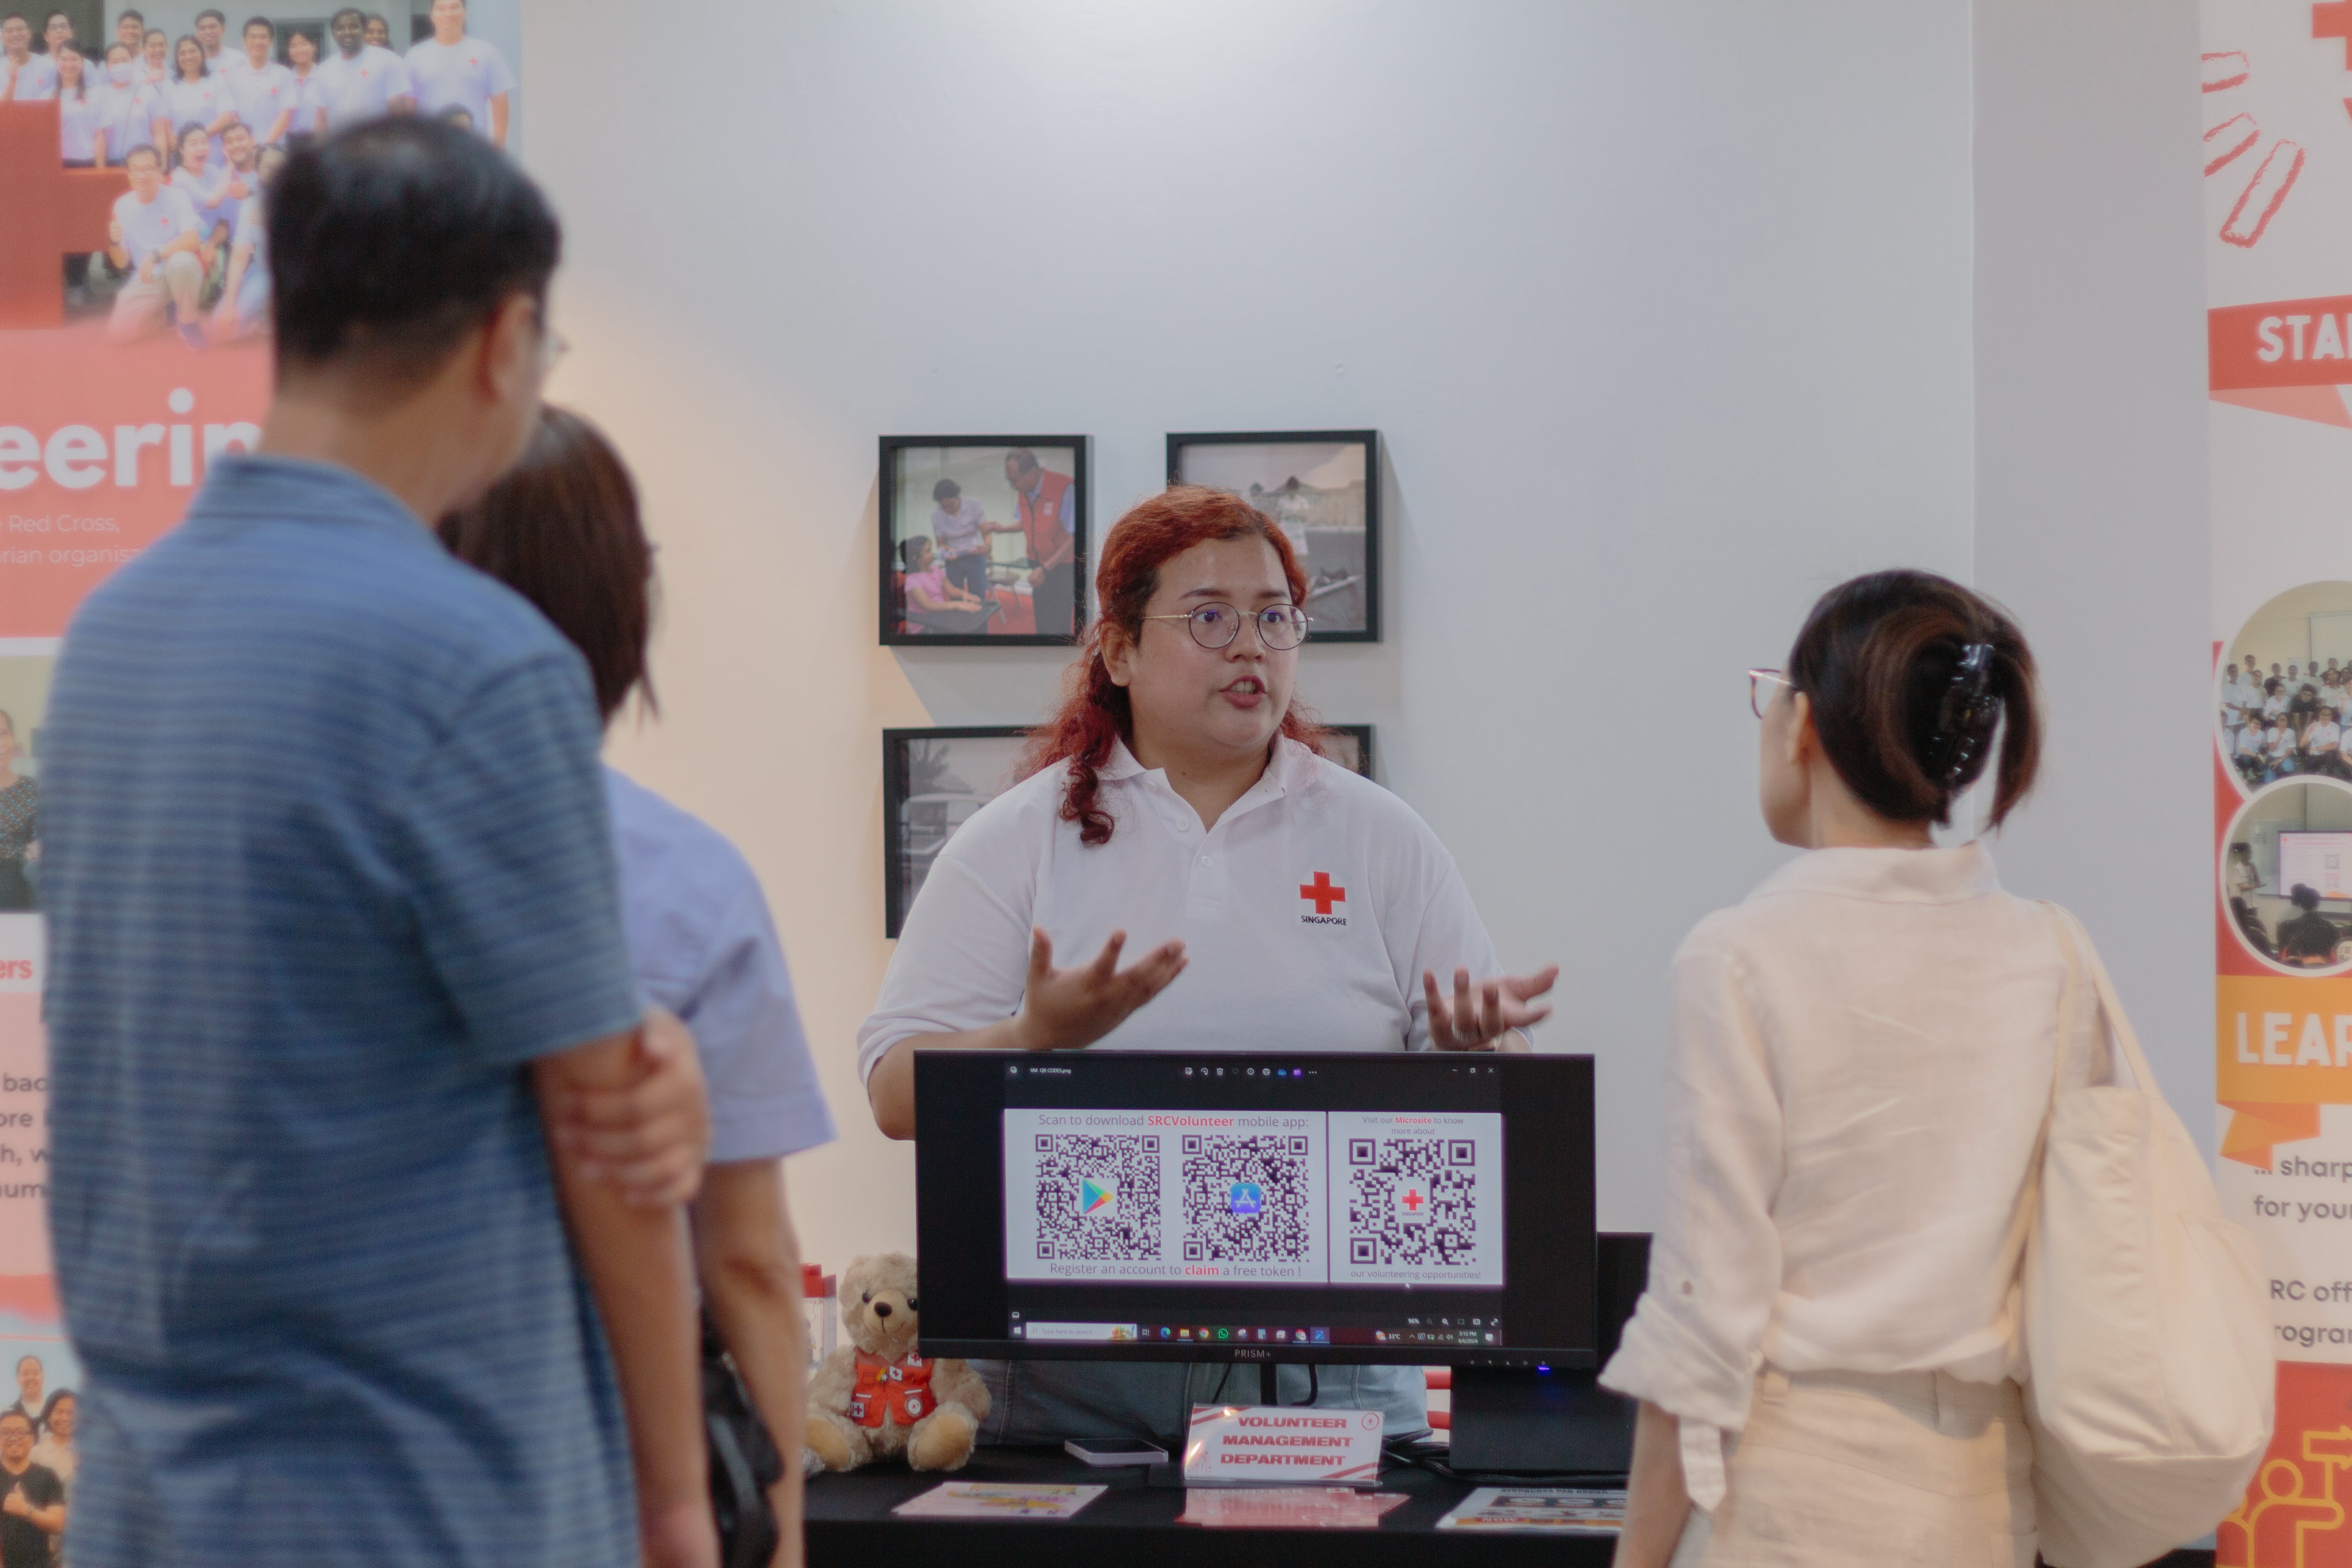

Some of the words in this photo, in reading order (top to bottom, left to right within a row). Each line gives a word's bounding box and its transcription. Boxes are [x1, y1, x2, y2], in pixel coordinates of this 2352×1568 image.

[2258, 313, 2352, 362] STA
[9, 514, 50, 532] Red
[57, 514, 120, 534] Cross,
[0, 546, 43, 564] rian
[1301, 916, 1347, 926] SINGAPORE
[1039, 1114, 1066, 1125] Scan
[1070, 1116, 1082, 1125] to
[1086, 1115, 1144, 1126] download
[1148, 1116, 1234, 1127] SRCVolunteer
[1238, 1116, 1279, 1127] mobile
[1283, 1118, 1308, 1130] app:
[2254, 1195, 2291, 1217] for
[2297, 1201, 2352, 1223] you
[1050, 1263, 1098, 1276] Register
[1101, 1266, 1115, 1274] an
[1119, 1265, 1166, 1275] account
[1170, 1265, 1181, 1275] to
[1185, 1264, 1219, 1275] claim
[1223, 1267, 1230, 1276] a
[1233, 1265, 1257, 1276] free
[1261, 1265, 1294, 1276] token
[1367, 1269, 1420, 1280] volunteering
[1422, 1271, 1481, 1280] opportunities!
[1235, 1349, 1272, 1358] PRISM+
[1238, 1416, 1347, 1428] VOLUNTEER
[1222, 1435, 1354, 1447] MANAGEMENT
[1220, 1454, 1346, 1466] DEPARTMENT
